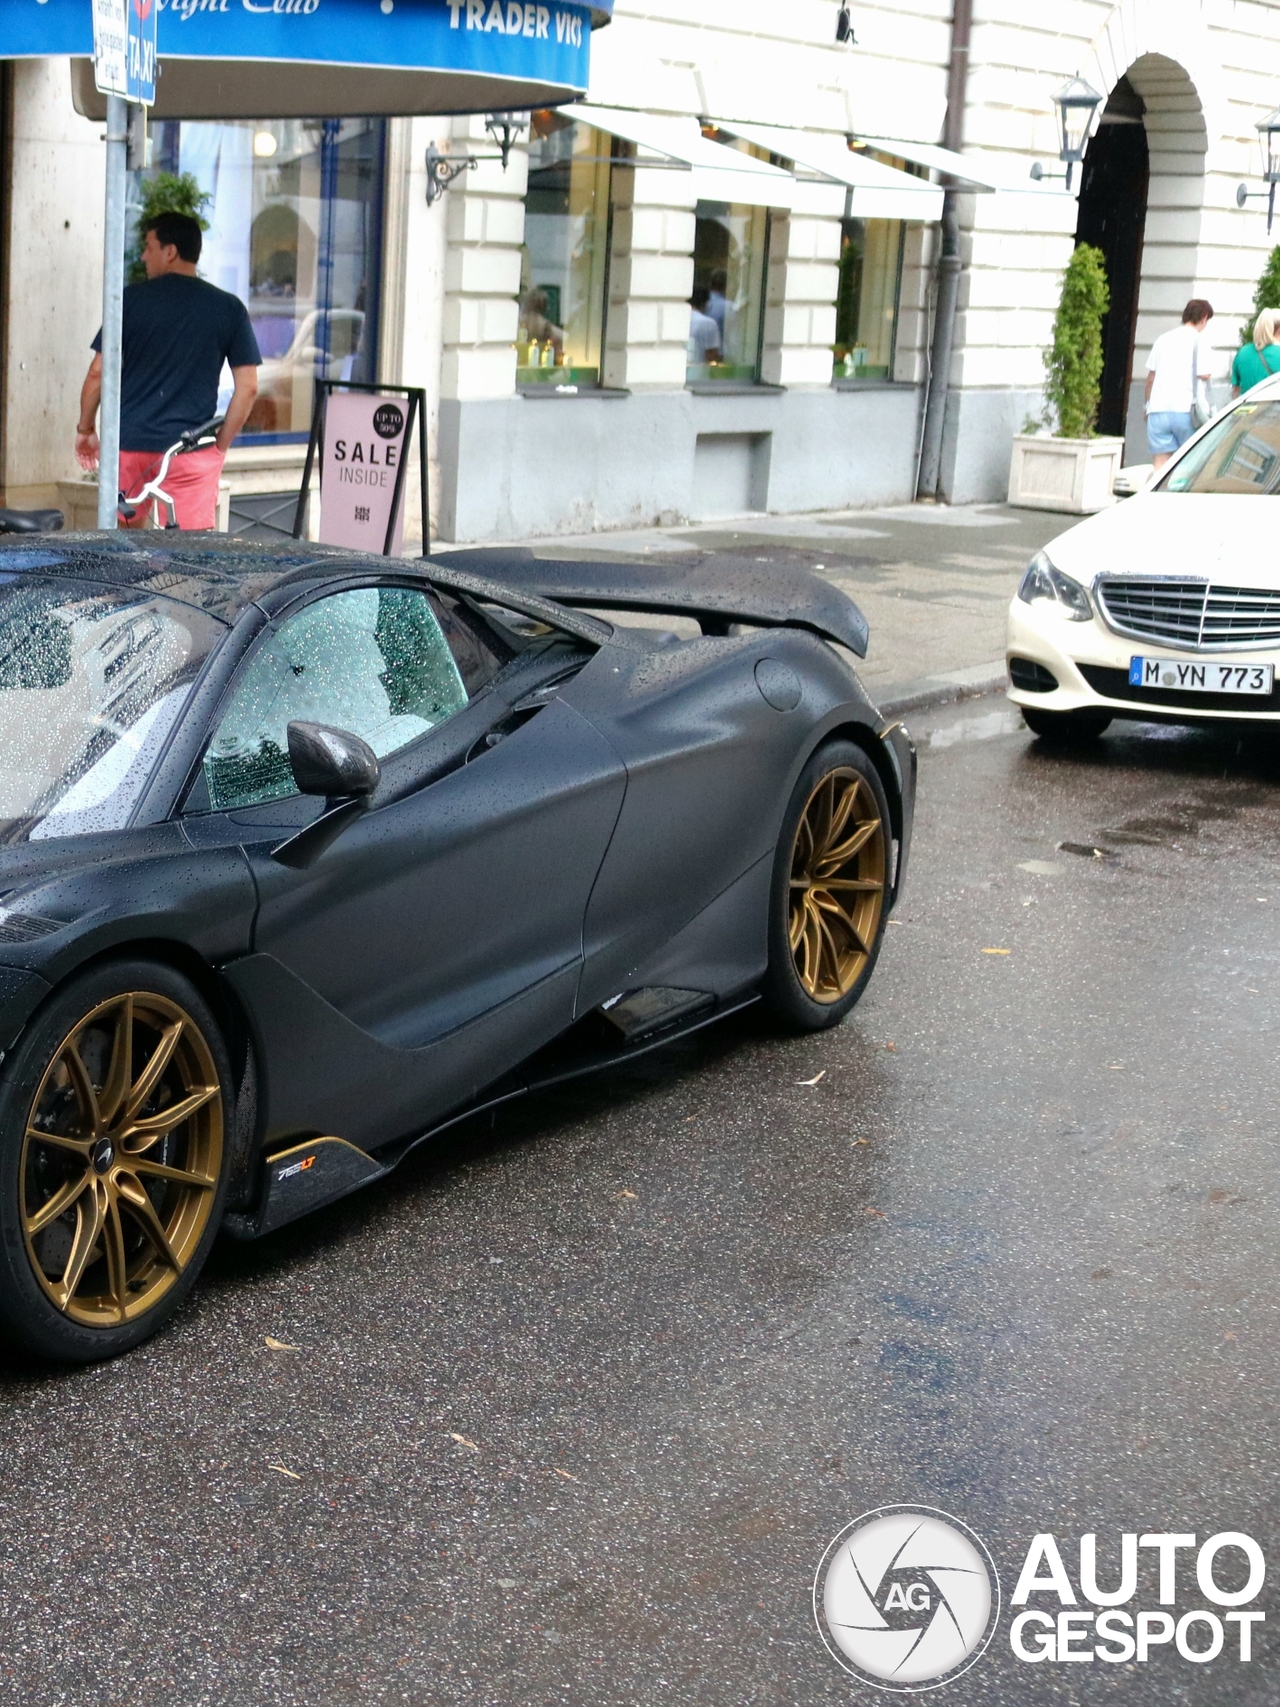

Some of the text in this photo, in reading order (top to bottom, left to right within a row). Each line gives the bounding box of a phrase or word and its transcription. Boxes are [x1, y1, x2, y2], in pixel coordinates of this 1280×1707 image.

[446, 0, 550, 39] TRADER
[129, 33, 154, 84] TAXI
[376, 412, 401, 423] UP TO
[334, 440, 397, 466] SALE
[339, 466, 388, 487] INSIDE
[1145, 662, 1264, 690] M YN 773
